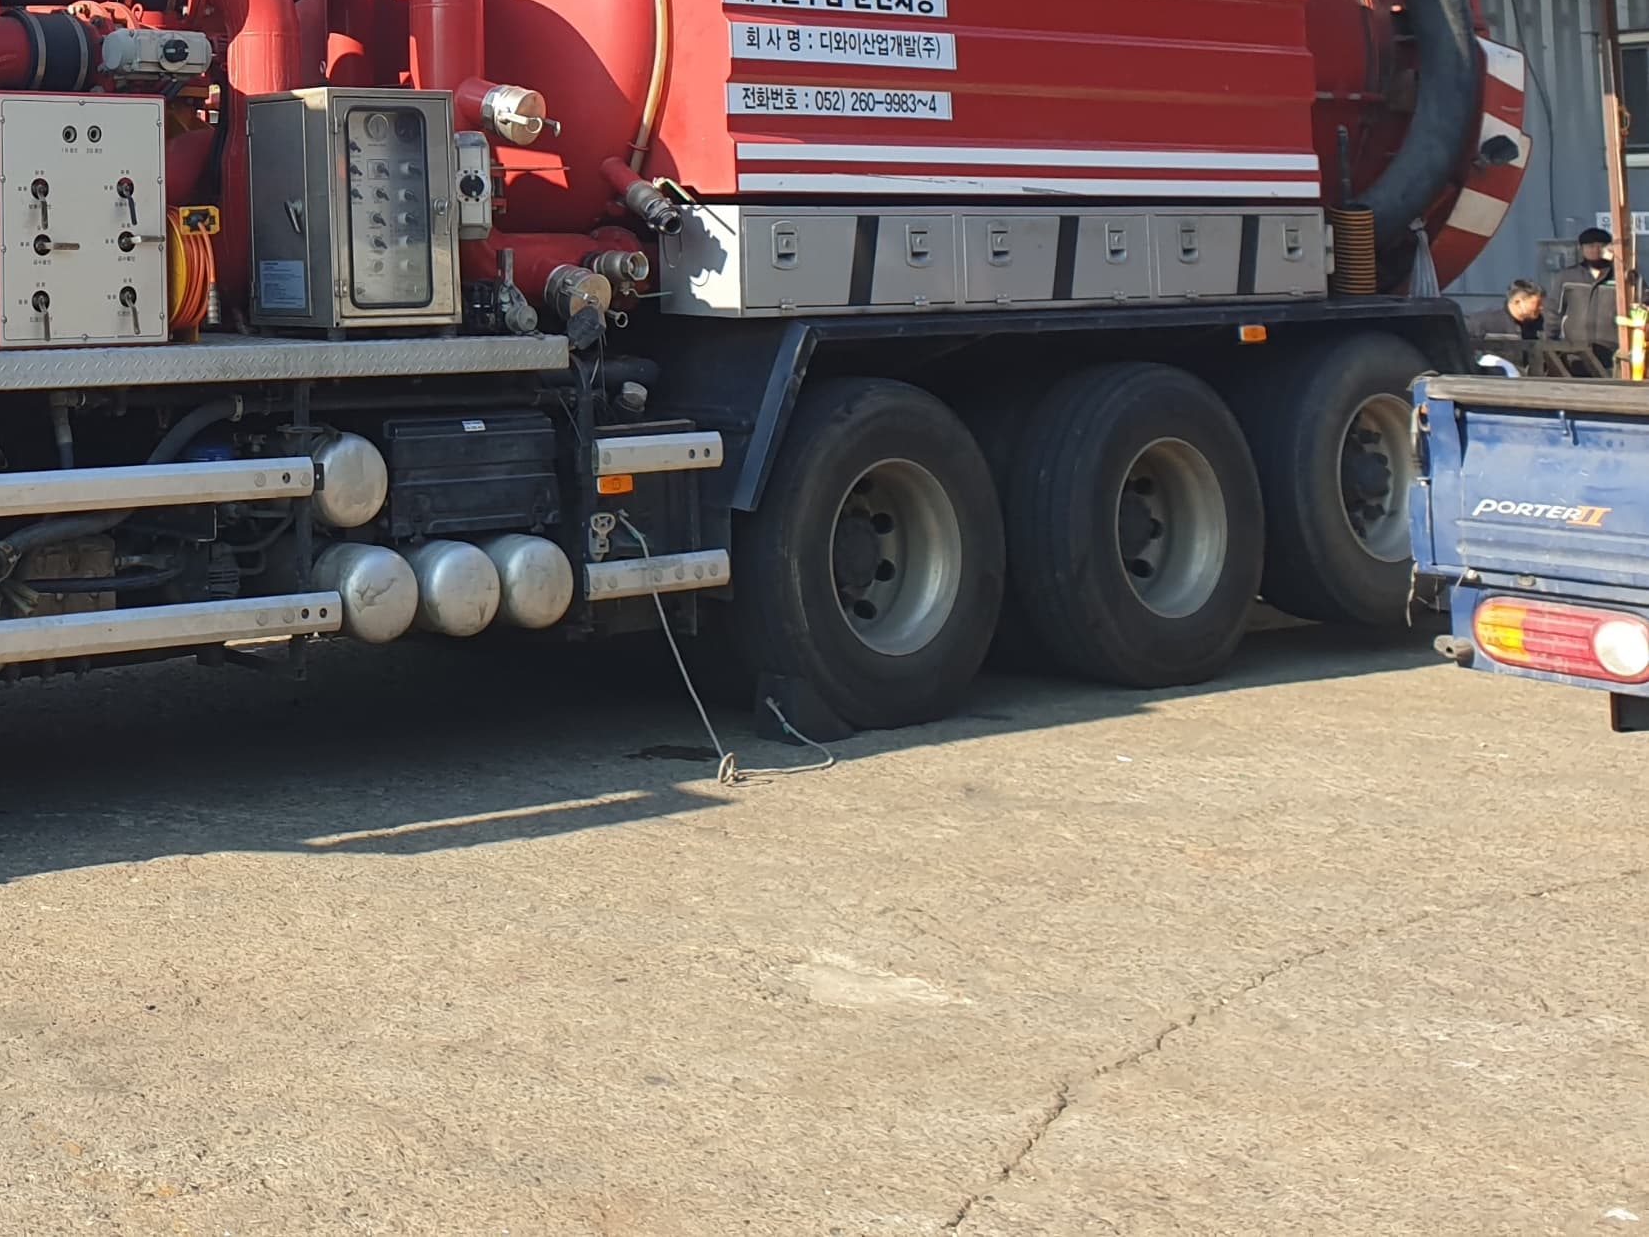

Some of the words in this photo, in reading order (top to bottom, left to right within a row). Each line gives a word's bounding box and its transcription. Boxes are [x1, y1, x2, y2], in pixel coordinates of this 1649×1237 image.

[820, 30, 941, 60] 디와이산업개발(주)
[742, 86, 798, 111] 전화번호
[815, 90, 845, 113] 052)
[851, 91, 937, 113] 260-9983~4
